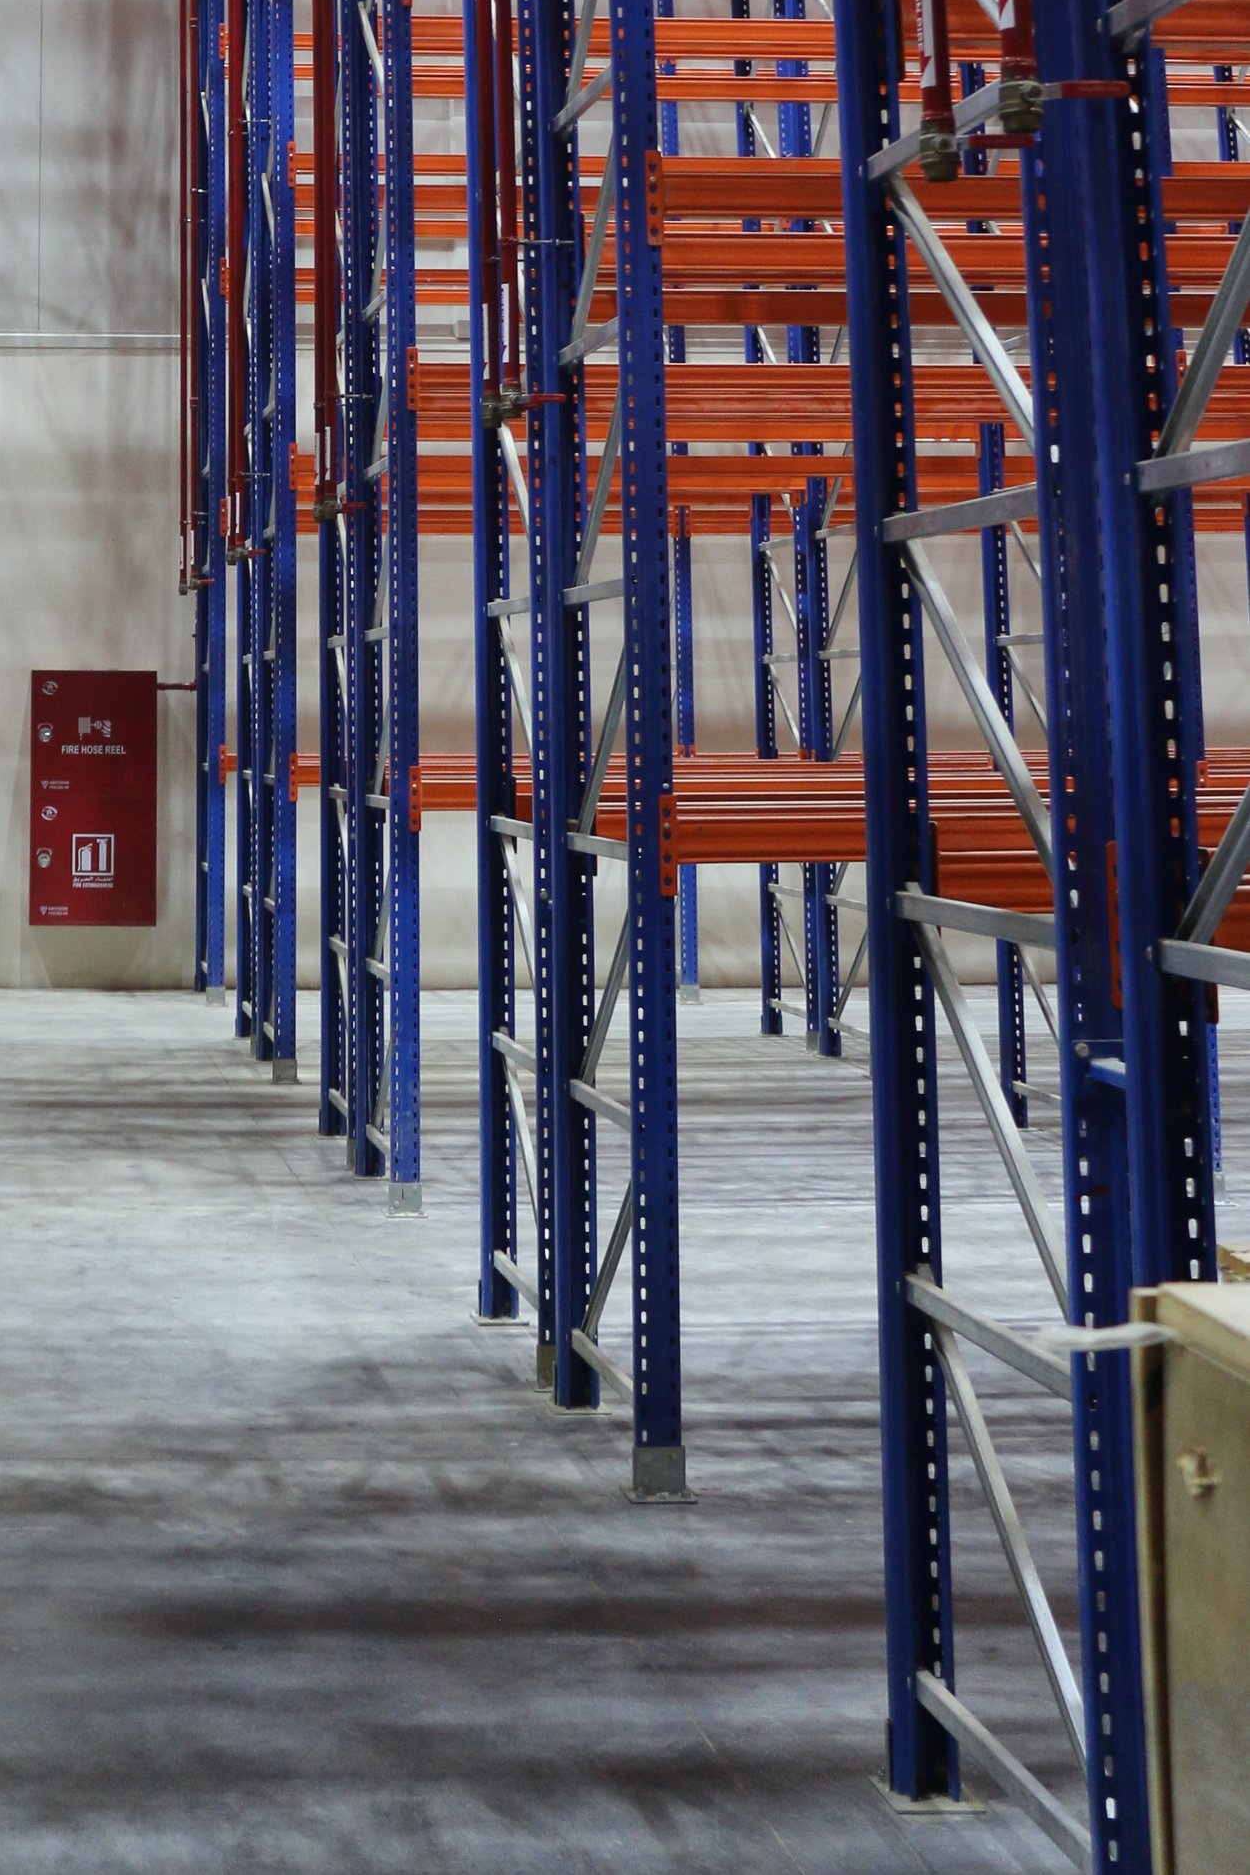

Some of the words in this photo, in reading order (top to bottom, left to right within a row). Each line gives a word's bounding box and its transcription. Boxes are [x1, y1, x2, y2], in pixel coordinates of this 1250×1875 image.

[61, 745, 79, 754] FIRE
[81, 745, 103, 754] HOSE
[105, 745, 126, 754] REEL
